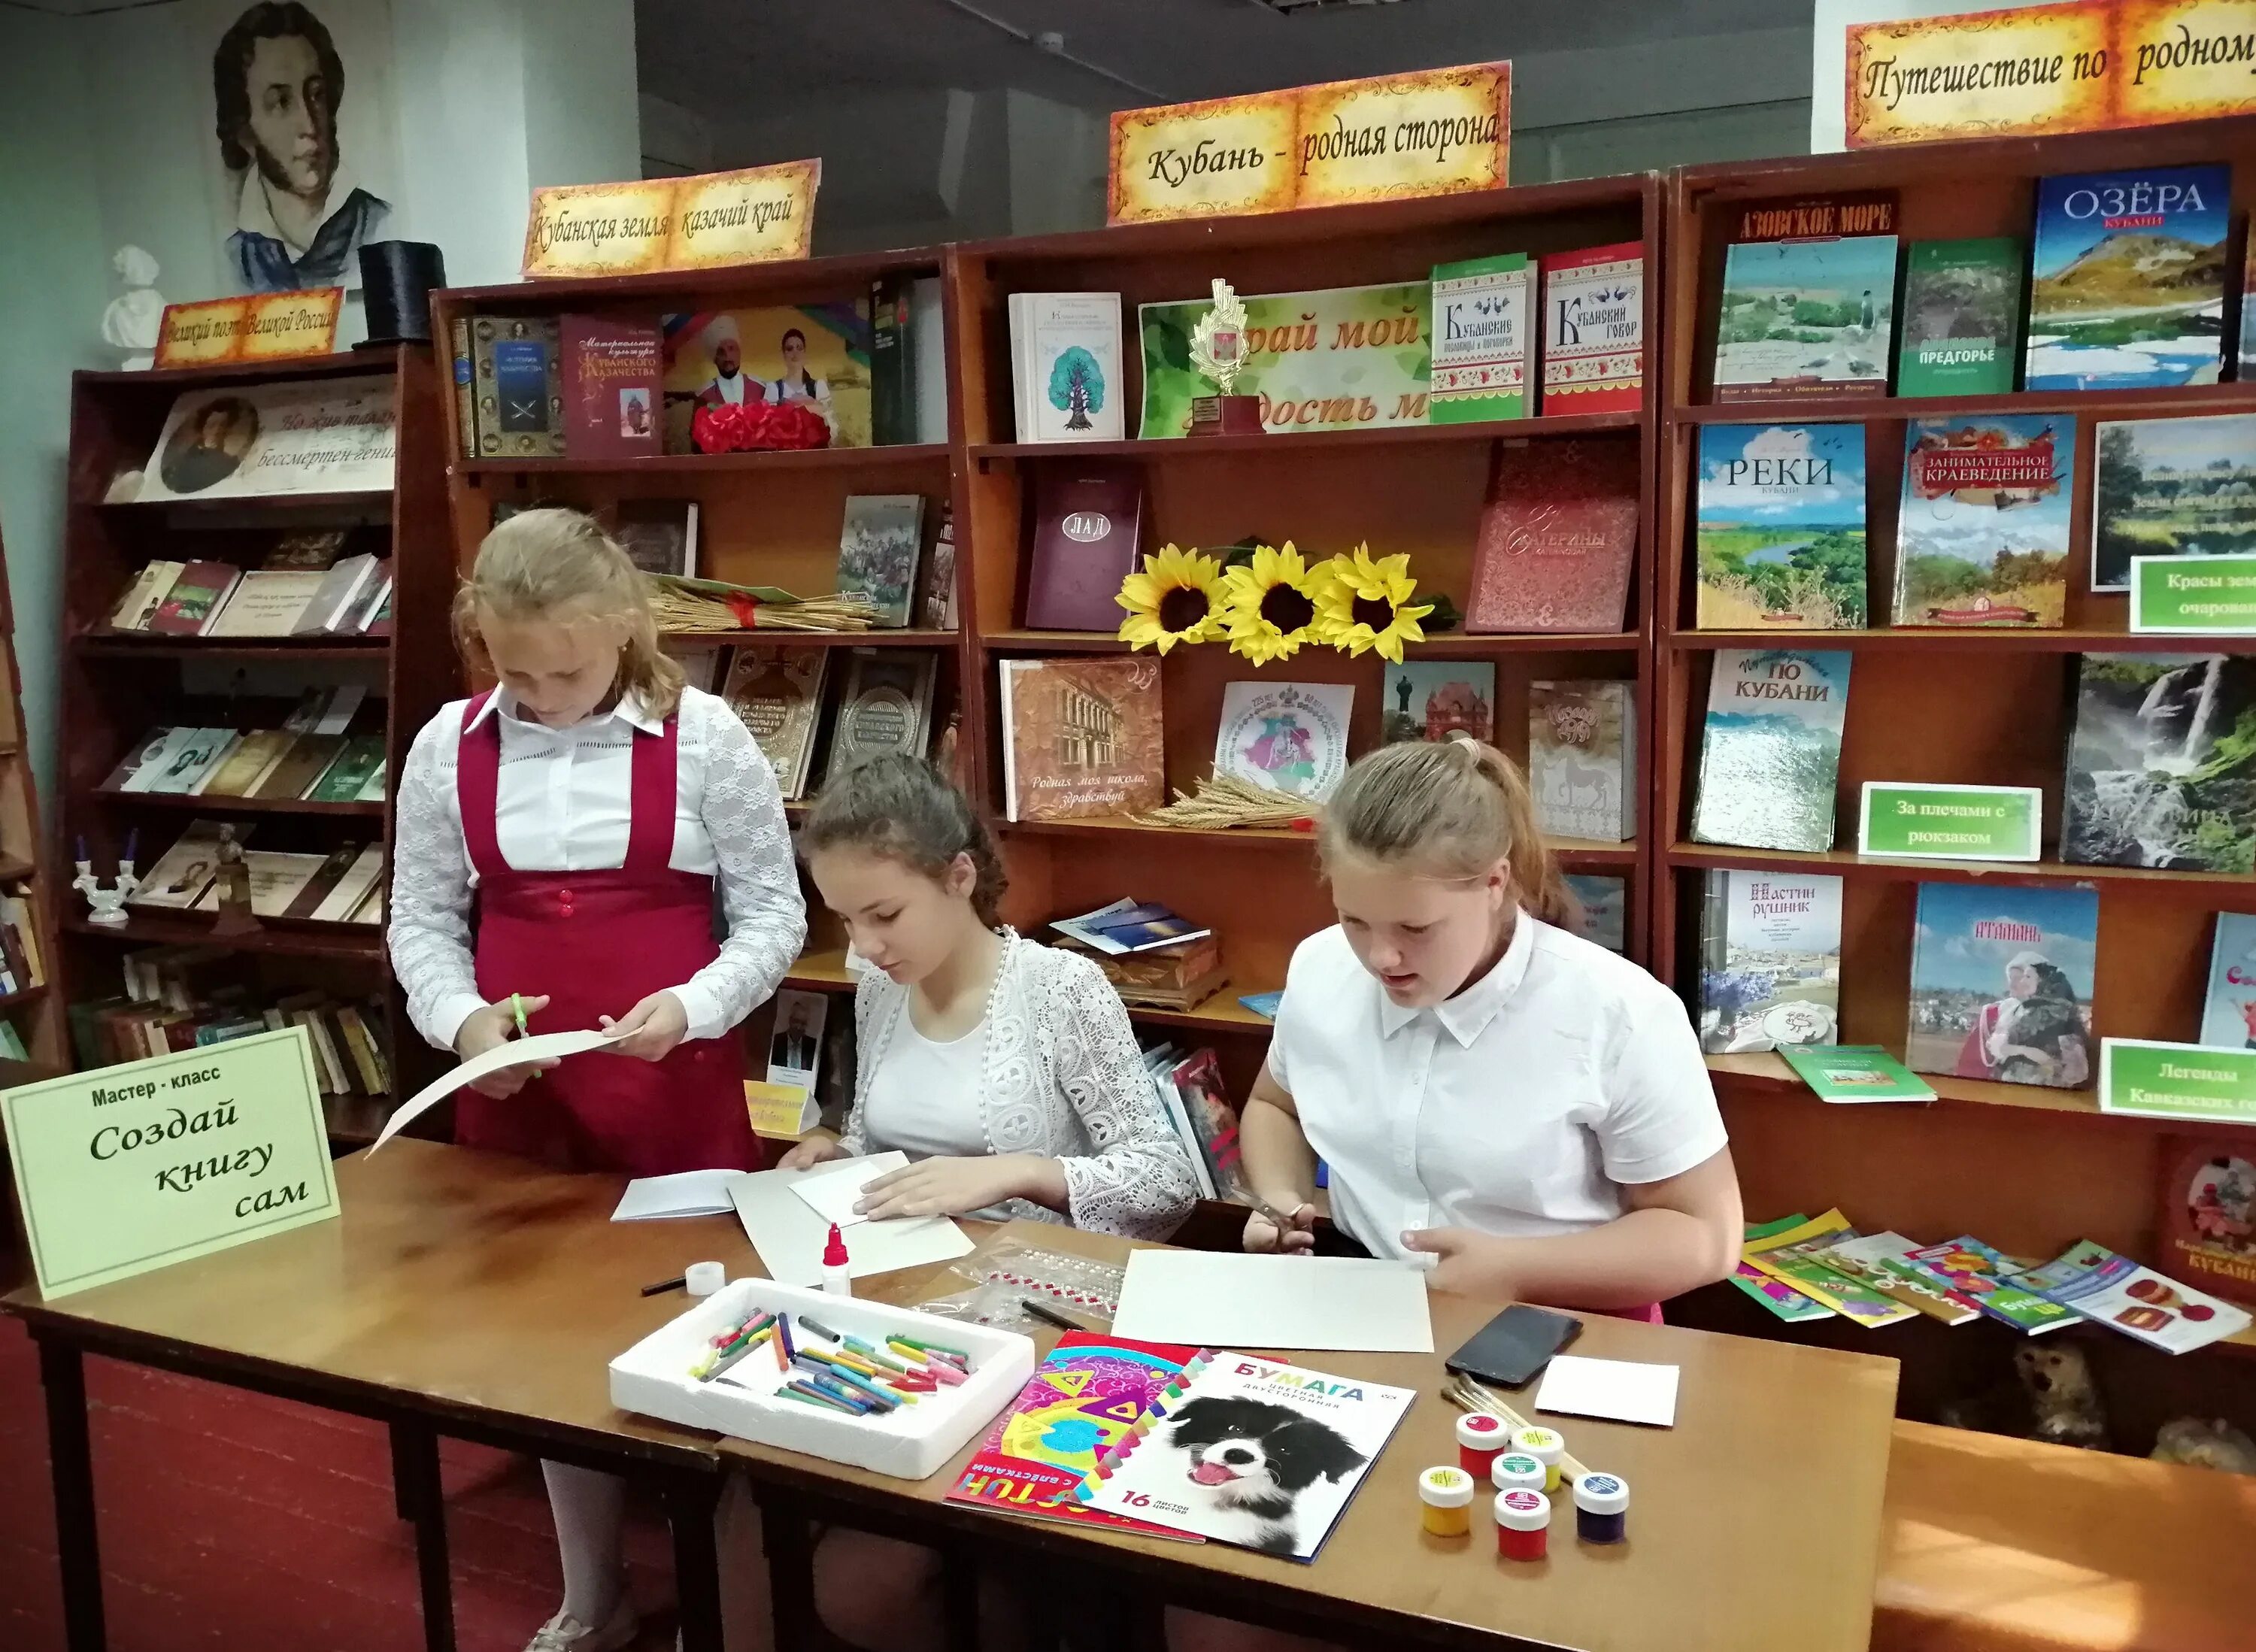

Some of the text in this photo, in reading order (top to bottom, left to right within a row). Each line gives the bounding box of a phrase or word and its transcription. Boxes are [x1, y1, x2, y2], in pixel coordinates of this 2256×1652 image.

[1864, 25, 2256, 111] Путешествие по родном
[1148, 140, 1264, 187] Кубань
[1300, 114, 1387, 176] родная
[1394, 112, 1500, 162] сторона
[2064, 181, 2207, 219] ОЗЁРА
[533, 192, 794, 253] Кубанская земля казачий край
[1740, 203, 1893, 239] АЗОВСКОЕ МОРЕ
[247, 311, 295, 338] Великой
[1242, 305, 1419, 365] рай мой
[1920, 350, 1995, 365] ПРЕДГОРЬЕ
[1727, 458, 1835, 486] РЕКИ
[1926, 455, 2050, 468] ЗАНИМАТЕЛЬНОЕ
[1926, 468, 2051, 482] КРАЕВЕДЕНИЕ
[1070, 517, 1105, 535] ЛАД
[2167, 574, 2222, 591] Красы
[1769, 662, 1801, 681] ПО
[1735, 681, 1830, 702] КУБАНИ
[1032, 776, 1072, 788] Родная
[1078, 776, 1101, 786] моя
[1059, 789, 1126, 809] здравствуй
[1897, 799, 2006, 817] За плечами с
[1907, 831, 1991, 845] рюкзаком
[2157, 1062, 2239, 1082] Легенды
[92, 1078, 156, 1107] Мастер
[171, 1066, 222, 1090] класс
[2129, 1087, 2234, 1108] Кавказских
[89, 1098, 240, 1160] Создай
[154, 1142, 274, 1193] книгу
[235, 1181, 309, 1218] сам
[1234, 1363, 1363, 1402] БУМАГА
[1269, 1383, 1324, 1400] ЦВЕТНАЯ
[1242, 1383, 1340, 1409] ДВУСТОРОННЯЯ
[1121, 1490, 1152, 1507] 16
